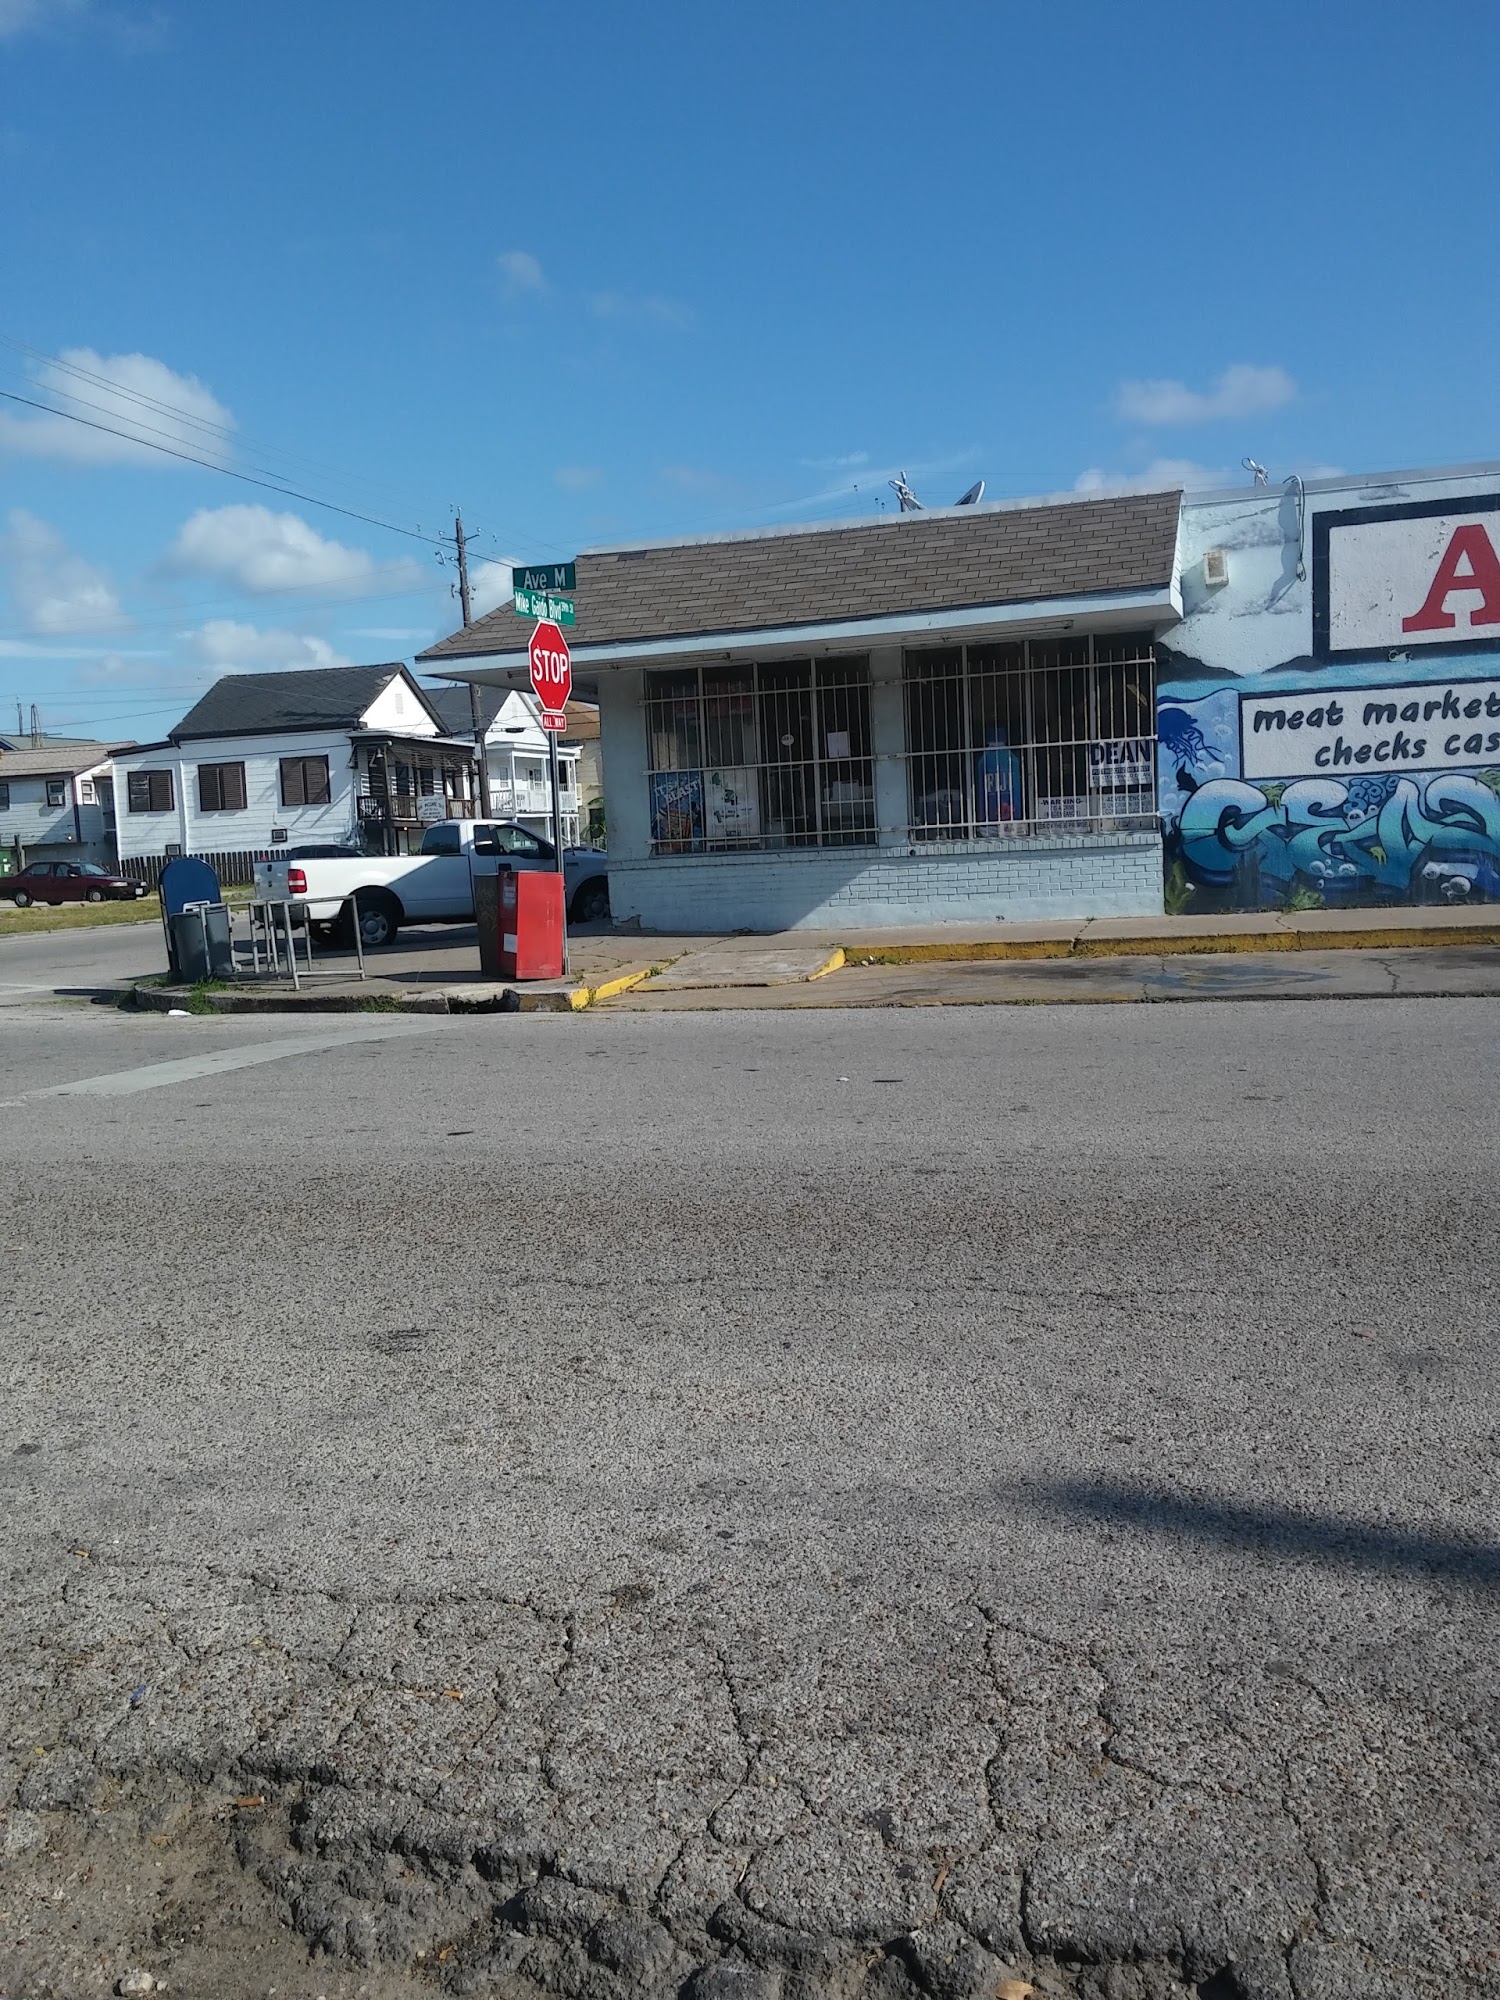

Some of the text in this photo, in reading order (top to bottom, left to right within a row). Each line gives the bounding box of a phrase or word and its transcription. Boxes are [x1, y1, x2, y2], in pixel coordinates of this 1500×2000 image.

[524, 567, 566, 590] Ave M
[515, 591, 530, 614] Mike
[549, 599, 561, 620] Blvd
[533, 648, 568, 684] STOP
[543, 716, 564, 728] ALL WAY
[1254, 689, 1500, 733] meat market
[1091, 742, 1151, 765] DEAN
[1315, 731, 1426, 767] checks
